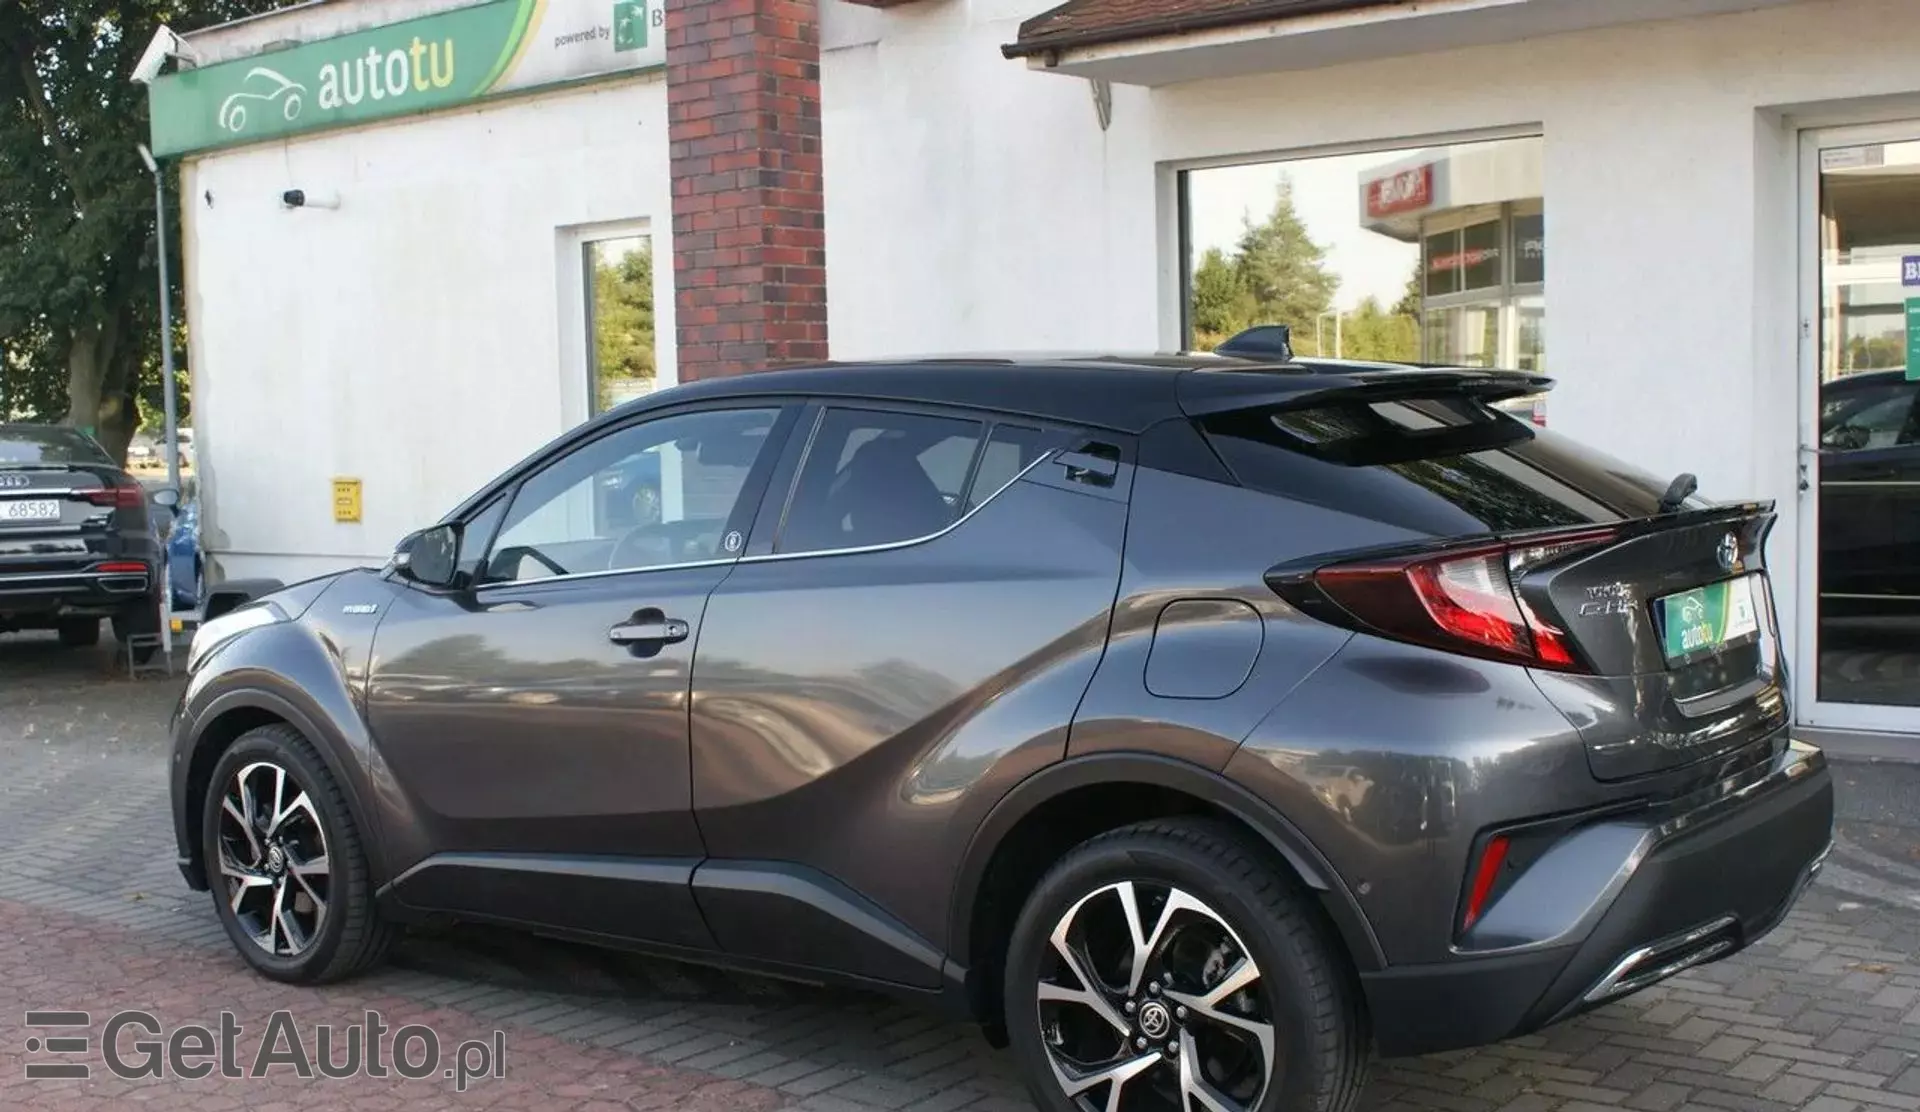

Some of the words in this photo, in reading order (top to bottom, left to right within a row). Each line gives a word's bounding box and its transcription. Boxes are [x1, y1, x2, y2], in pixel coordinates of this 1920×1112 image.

[554, 26, 596, 49] powered
[598, 25, 610, 40] by
[318, 36, 454, 110] autotu
[9, 502, 58, 517] 68582
